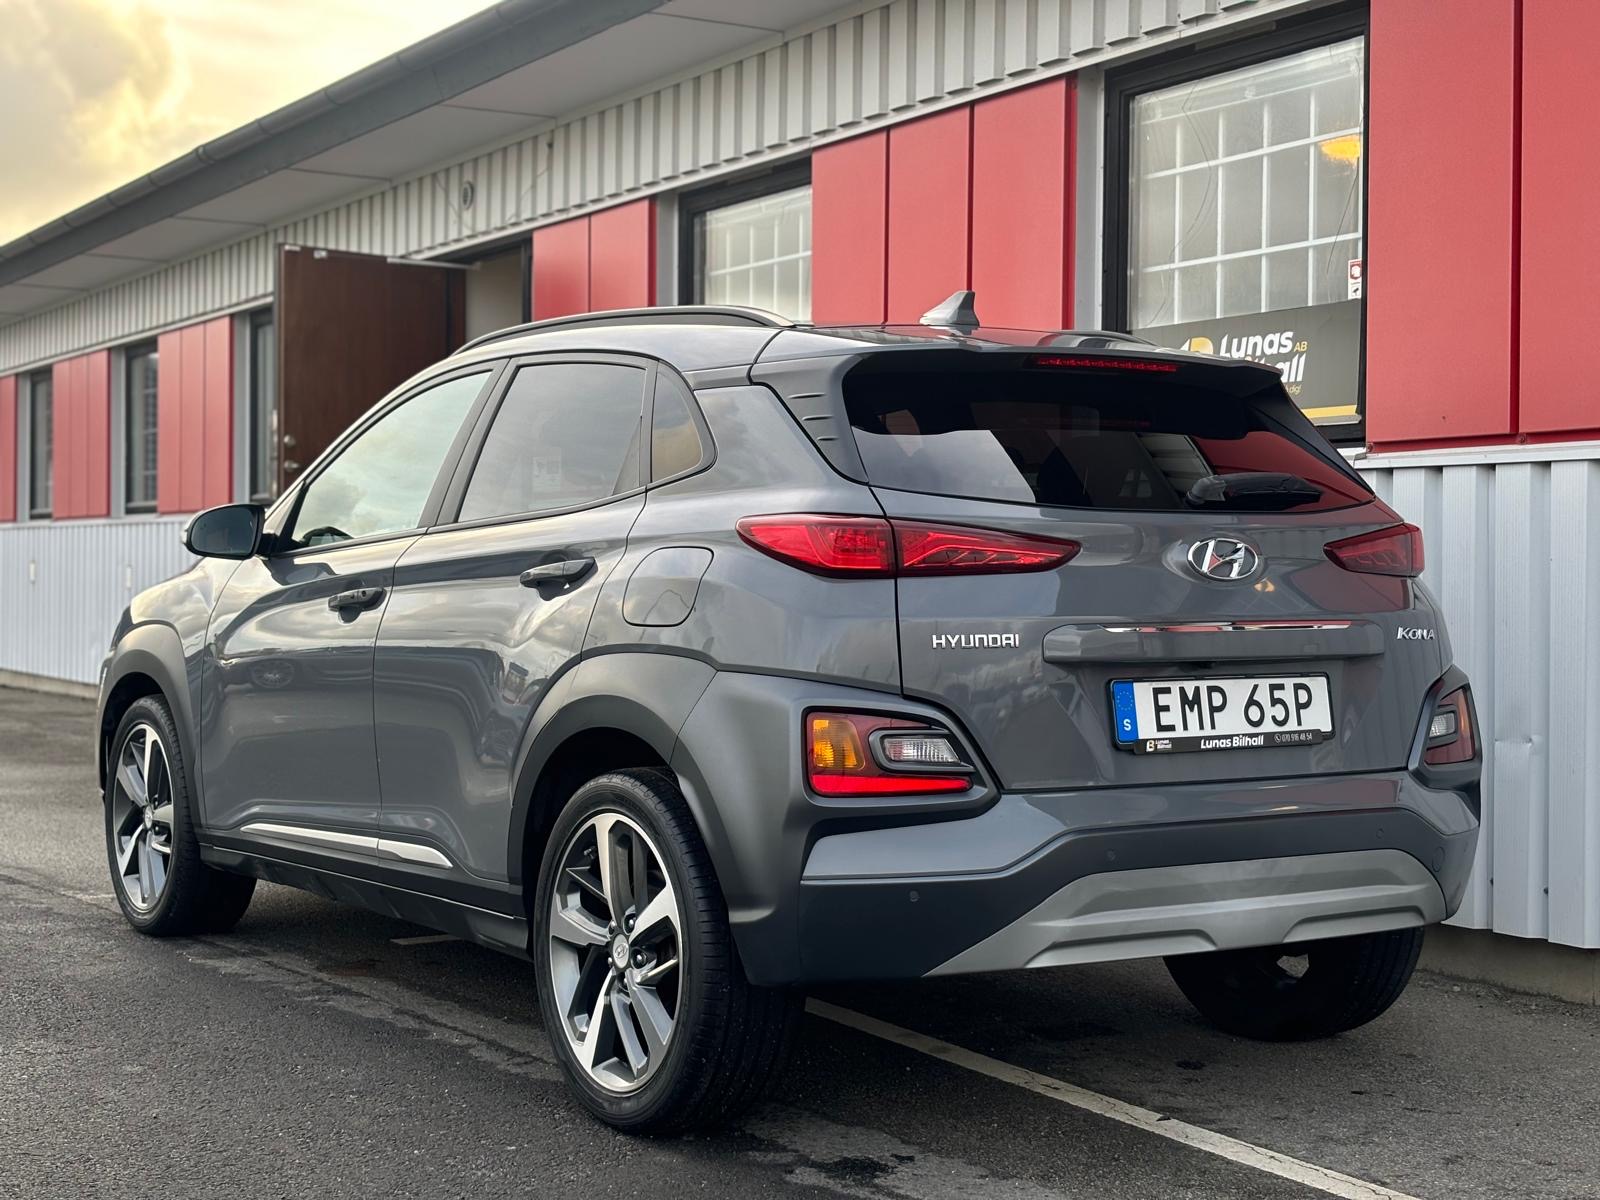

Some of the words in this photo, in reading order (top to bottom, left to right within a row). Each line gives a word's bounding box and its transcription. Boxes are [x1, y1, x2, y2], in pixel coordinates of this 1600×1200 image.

[1219, 331, 1294, 359] Lunas
[1293, 341, 1308, 352] AB
[1396, 626, 1436, 640] KONA
[931, 633, 1020, 649] HYUNDAI
[1152, 685, 1228, 732] EMP
[1243, 682, 1313, 728] 65P
[1123, 719, 1132, 731] S
[1200, 738, 1232, 749] Lunas
[1232, 734, 1265, 747] Bilhall
